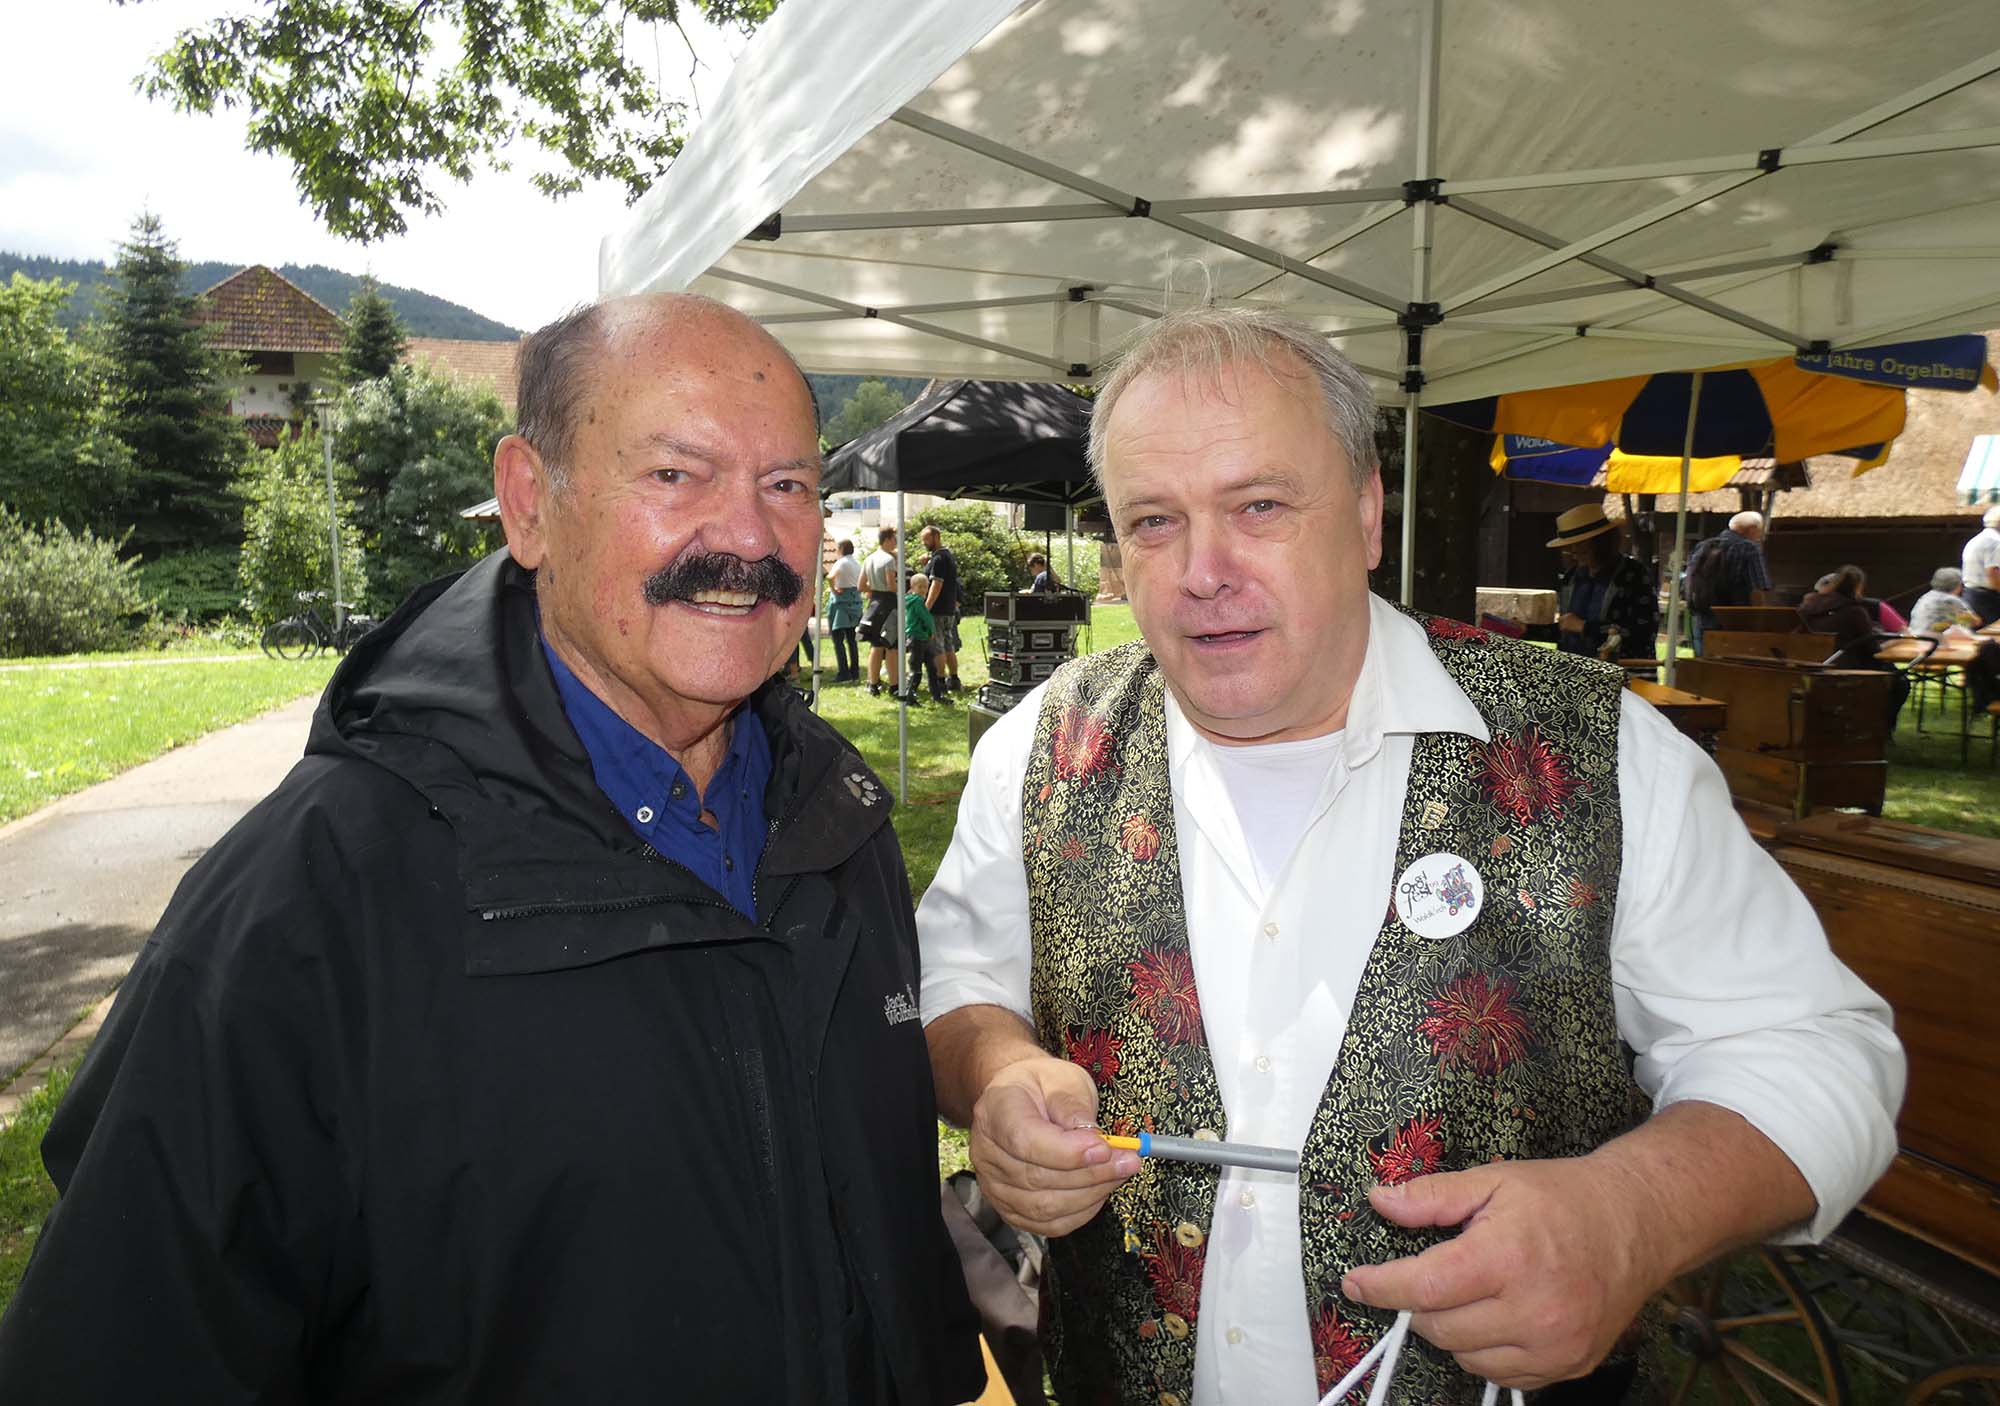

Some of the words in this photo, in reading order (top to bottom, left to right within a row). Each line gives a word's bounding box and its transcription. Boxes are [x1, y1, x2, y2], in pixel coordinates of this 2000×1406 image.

[1827, 352, 1875, 371] Jahre
[1881, 357, 1977, 381] Orgelbau
[884, 992, 908, 1011] Jack
